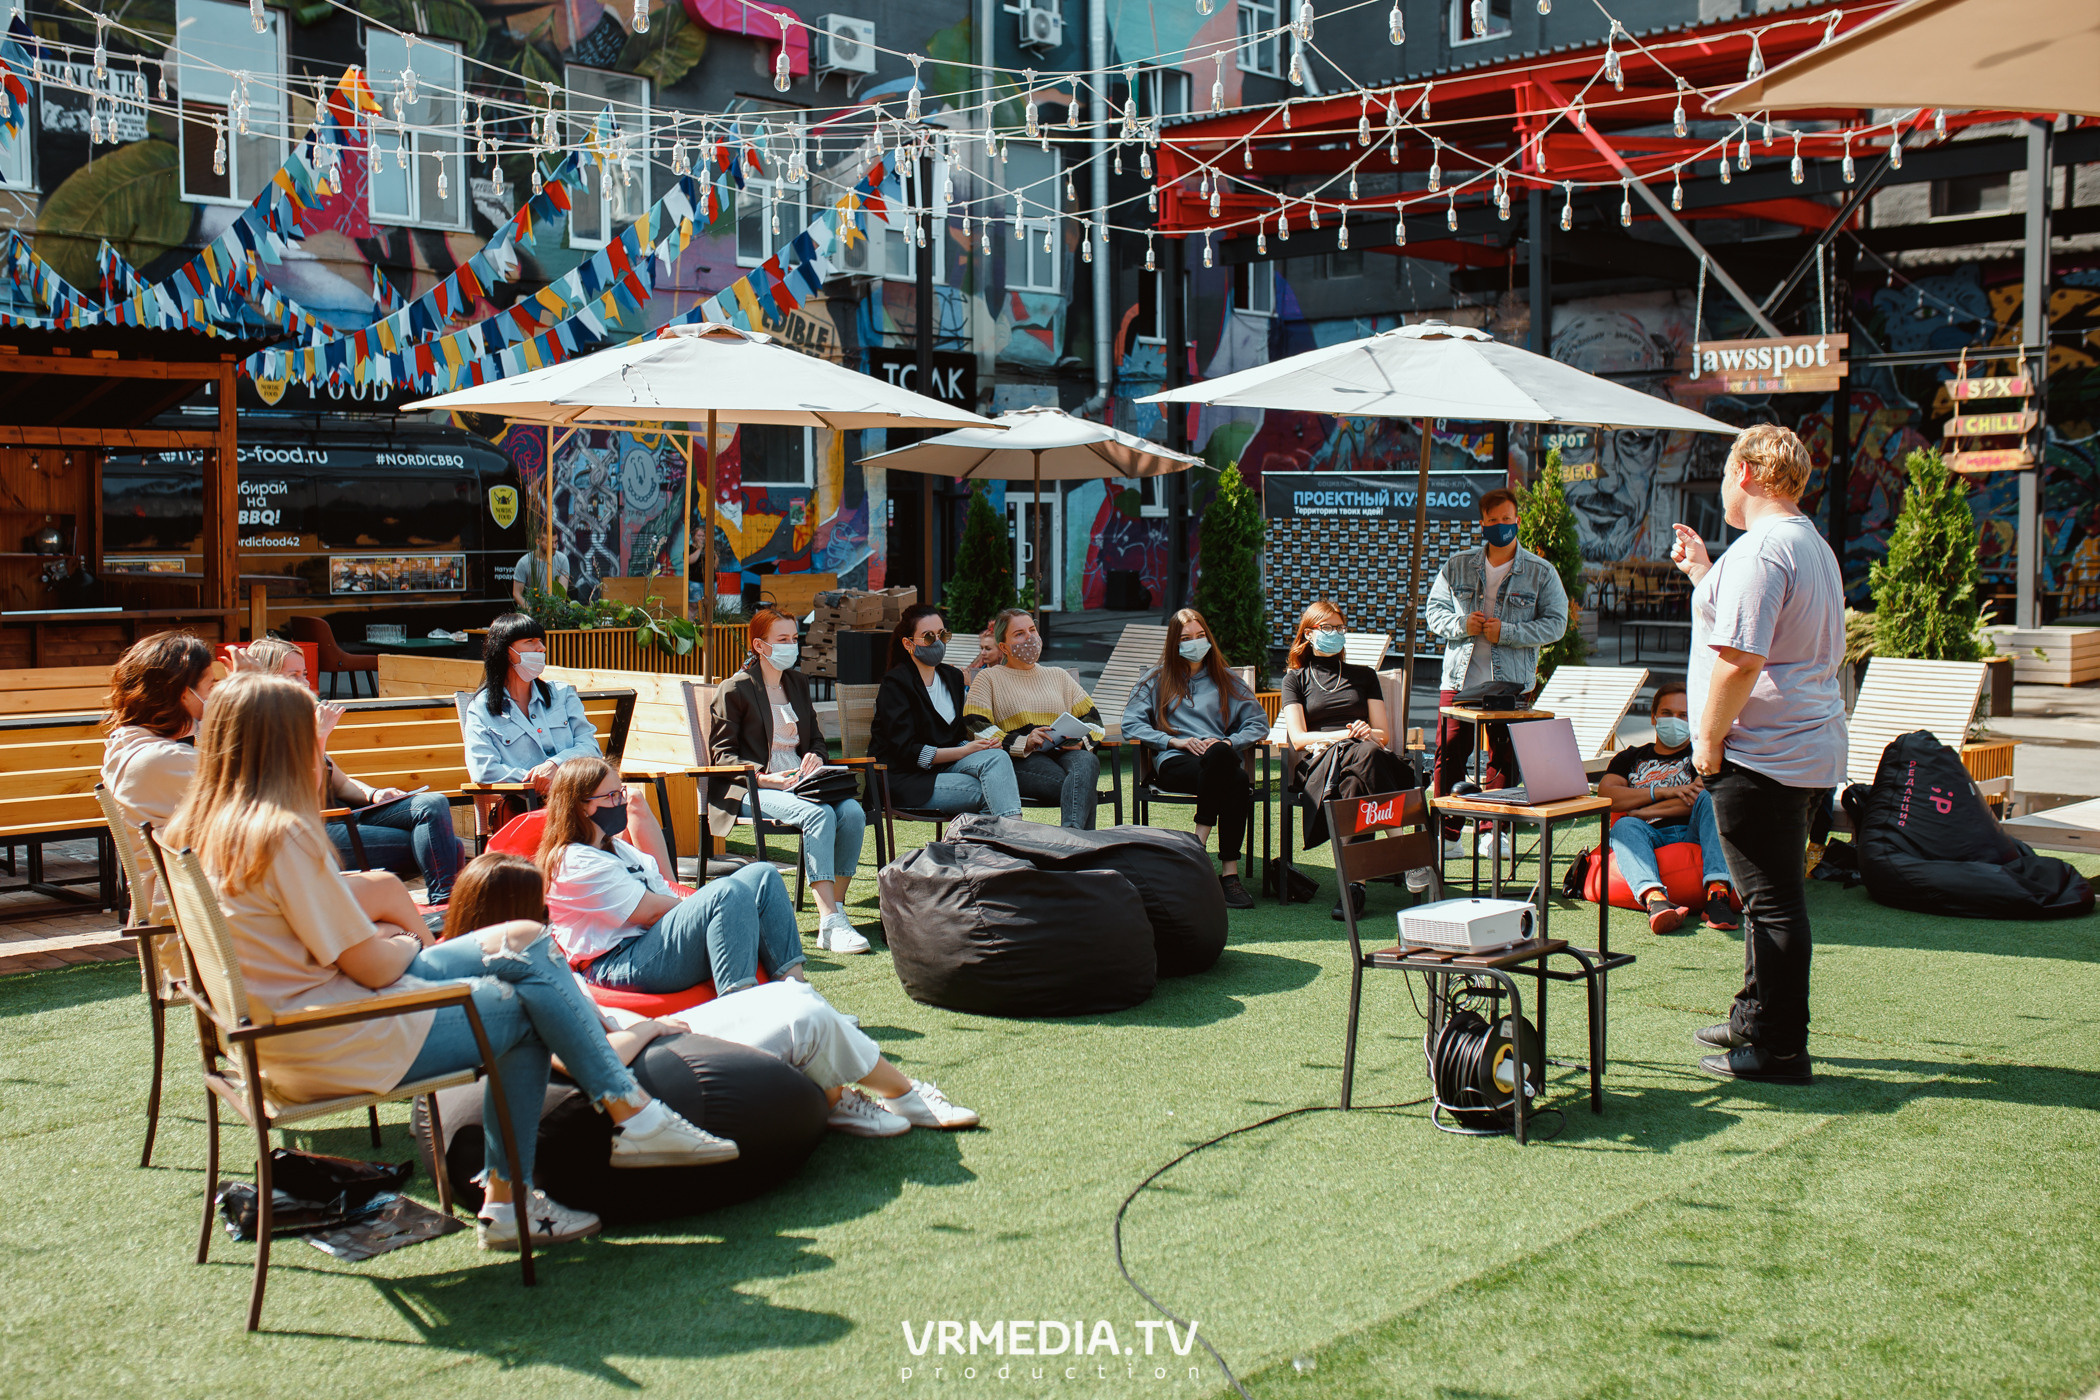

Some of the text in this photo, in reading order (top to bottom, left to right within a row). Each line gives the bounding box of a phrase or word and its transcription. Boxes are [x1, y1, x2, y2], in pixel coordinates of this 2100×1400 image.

[42, 63, 81, 86] MAN
[1689, 337, 1830, 380] jawsspot
[1967, 378, 2012, 398] S?X
[1966, 415, 2019, 433] CHILL
[1547, 432, 1587, 448] SPOT
[375, 453, 464, 468] #NORDICBBQ
[1560, 463, 1597, 482] EER
[237, 480, 288, 498] бирай
[1293, 488, 1471, 507] ПРОЕКТНЫЙ КУБАСС
[246, 496, 267, 508] на
[1294, 506, 1384, 516] Территория твоих идей!
[237, 509, 281, 526] BBQ!
[238, 536, 300, 547] rdicfood42
[1360, 800, 1395, 825] Bud
